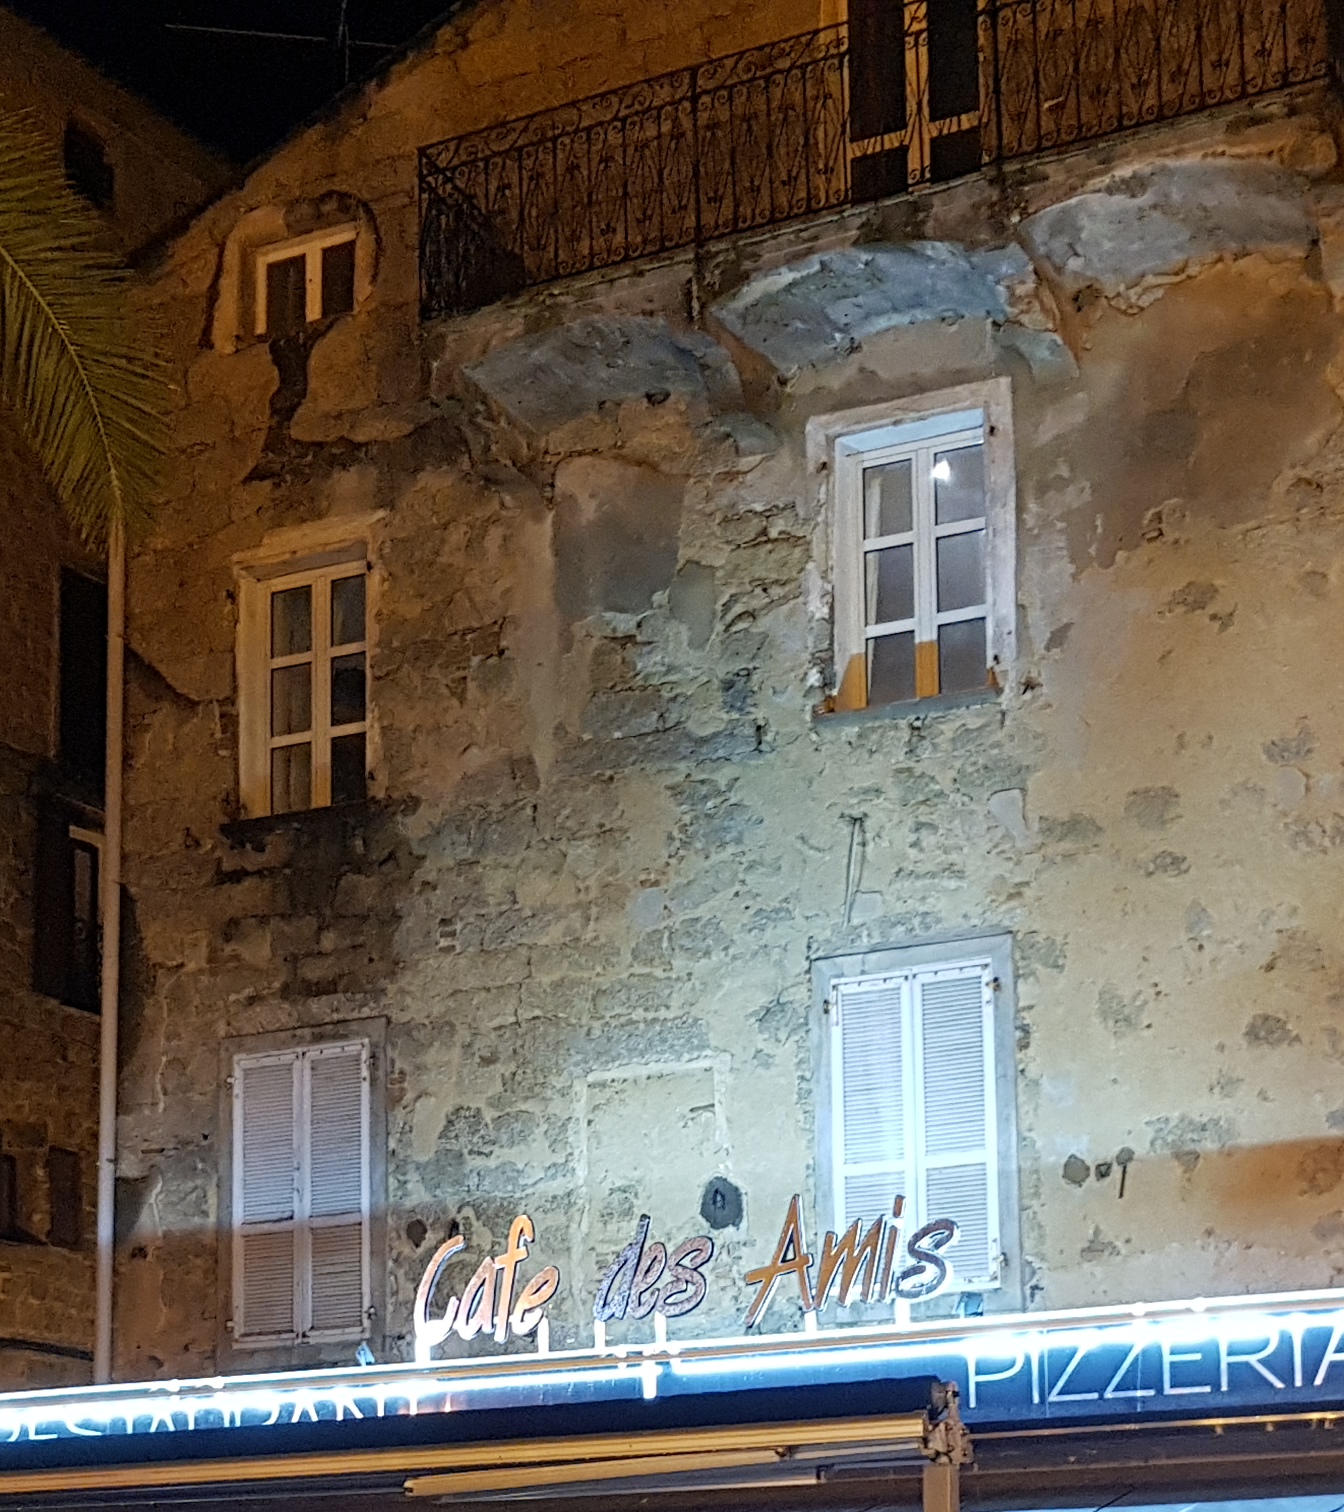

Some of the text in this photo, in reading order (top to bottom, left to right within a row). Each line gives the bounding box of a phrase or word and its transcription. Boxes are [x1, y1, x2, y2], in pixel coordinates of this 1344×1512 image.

[413, 1194, 958, 1345] Cafe des Amis
